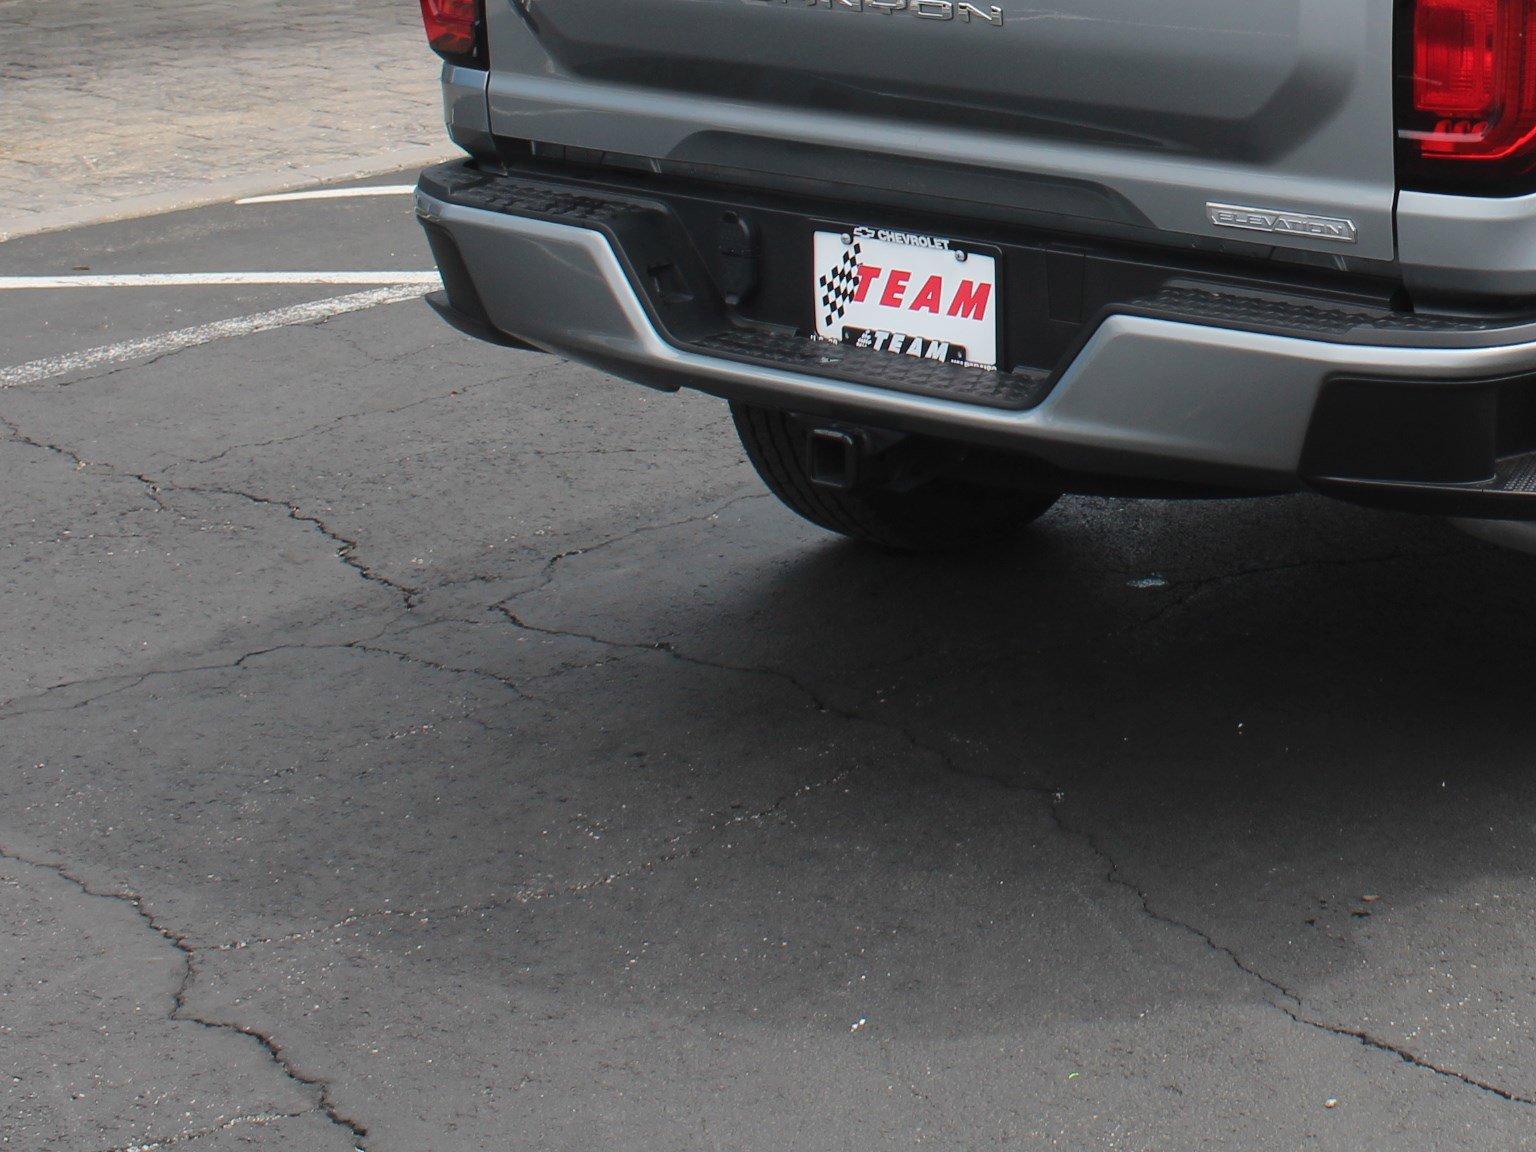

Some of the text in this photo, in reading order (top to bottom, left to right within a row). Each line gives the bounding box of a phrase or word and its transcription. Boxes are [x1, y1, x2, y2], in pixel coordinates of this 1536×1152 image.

[1217, 210, 1344, 235] ELEVATION
[877, 229, 951, 251] CHEVROLET
[853, 264, 993, 322] TEAM
[872, 330, 950, 364] TEAM
